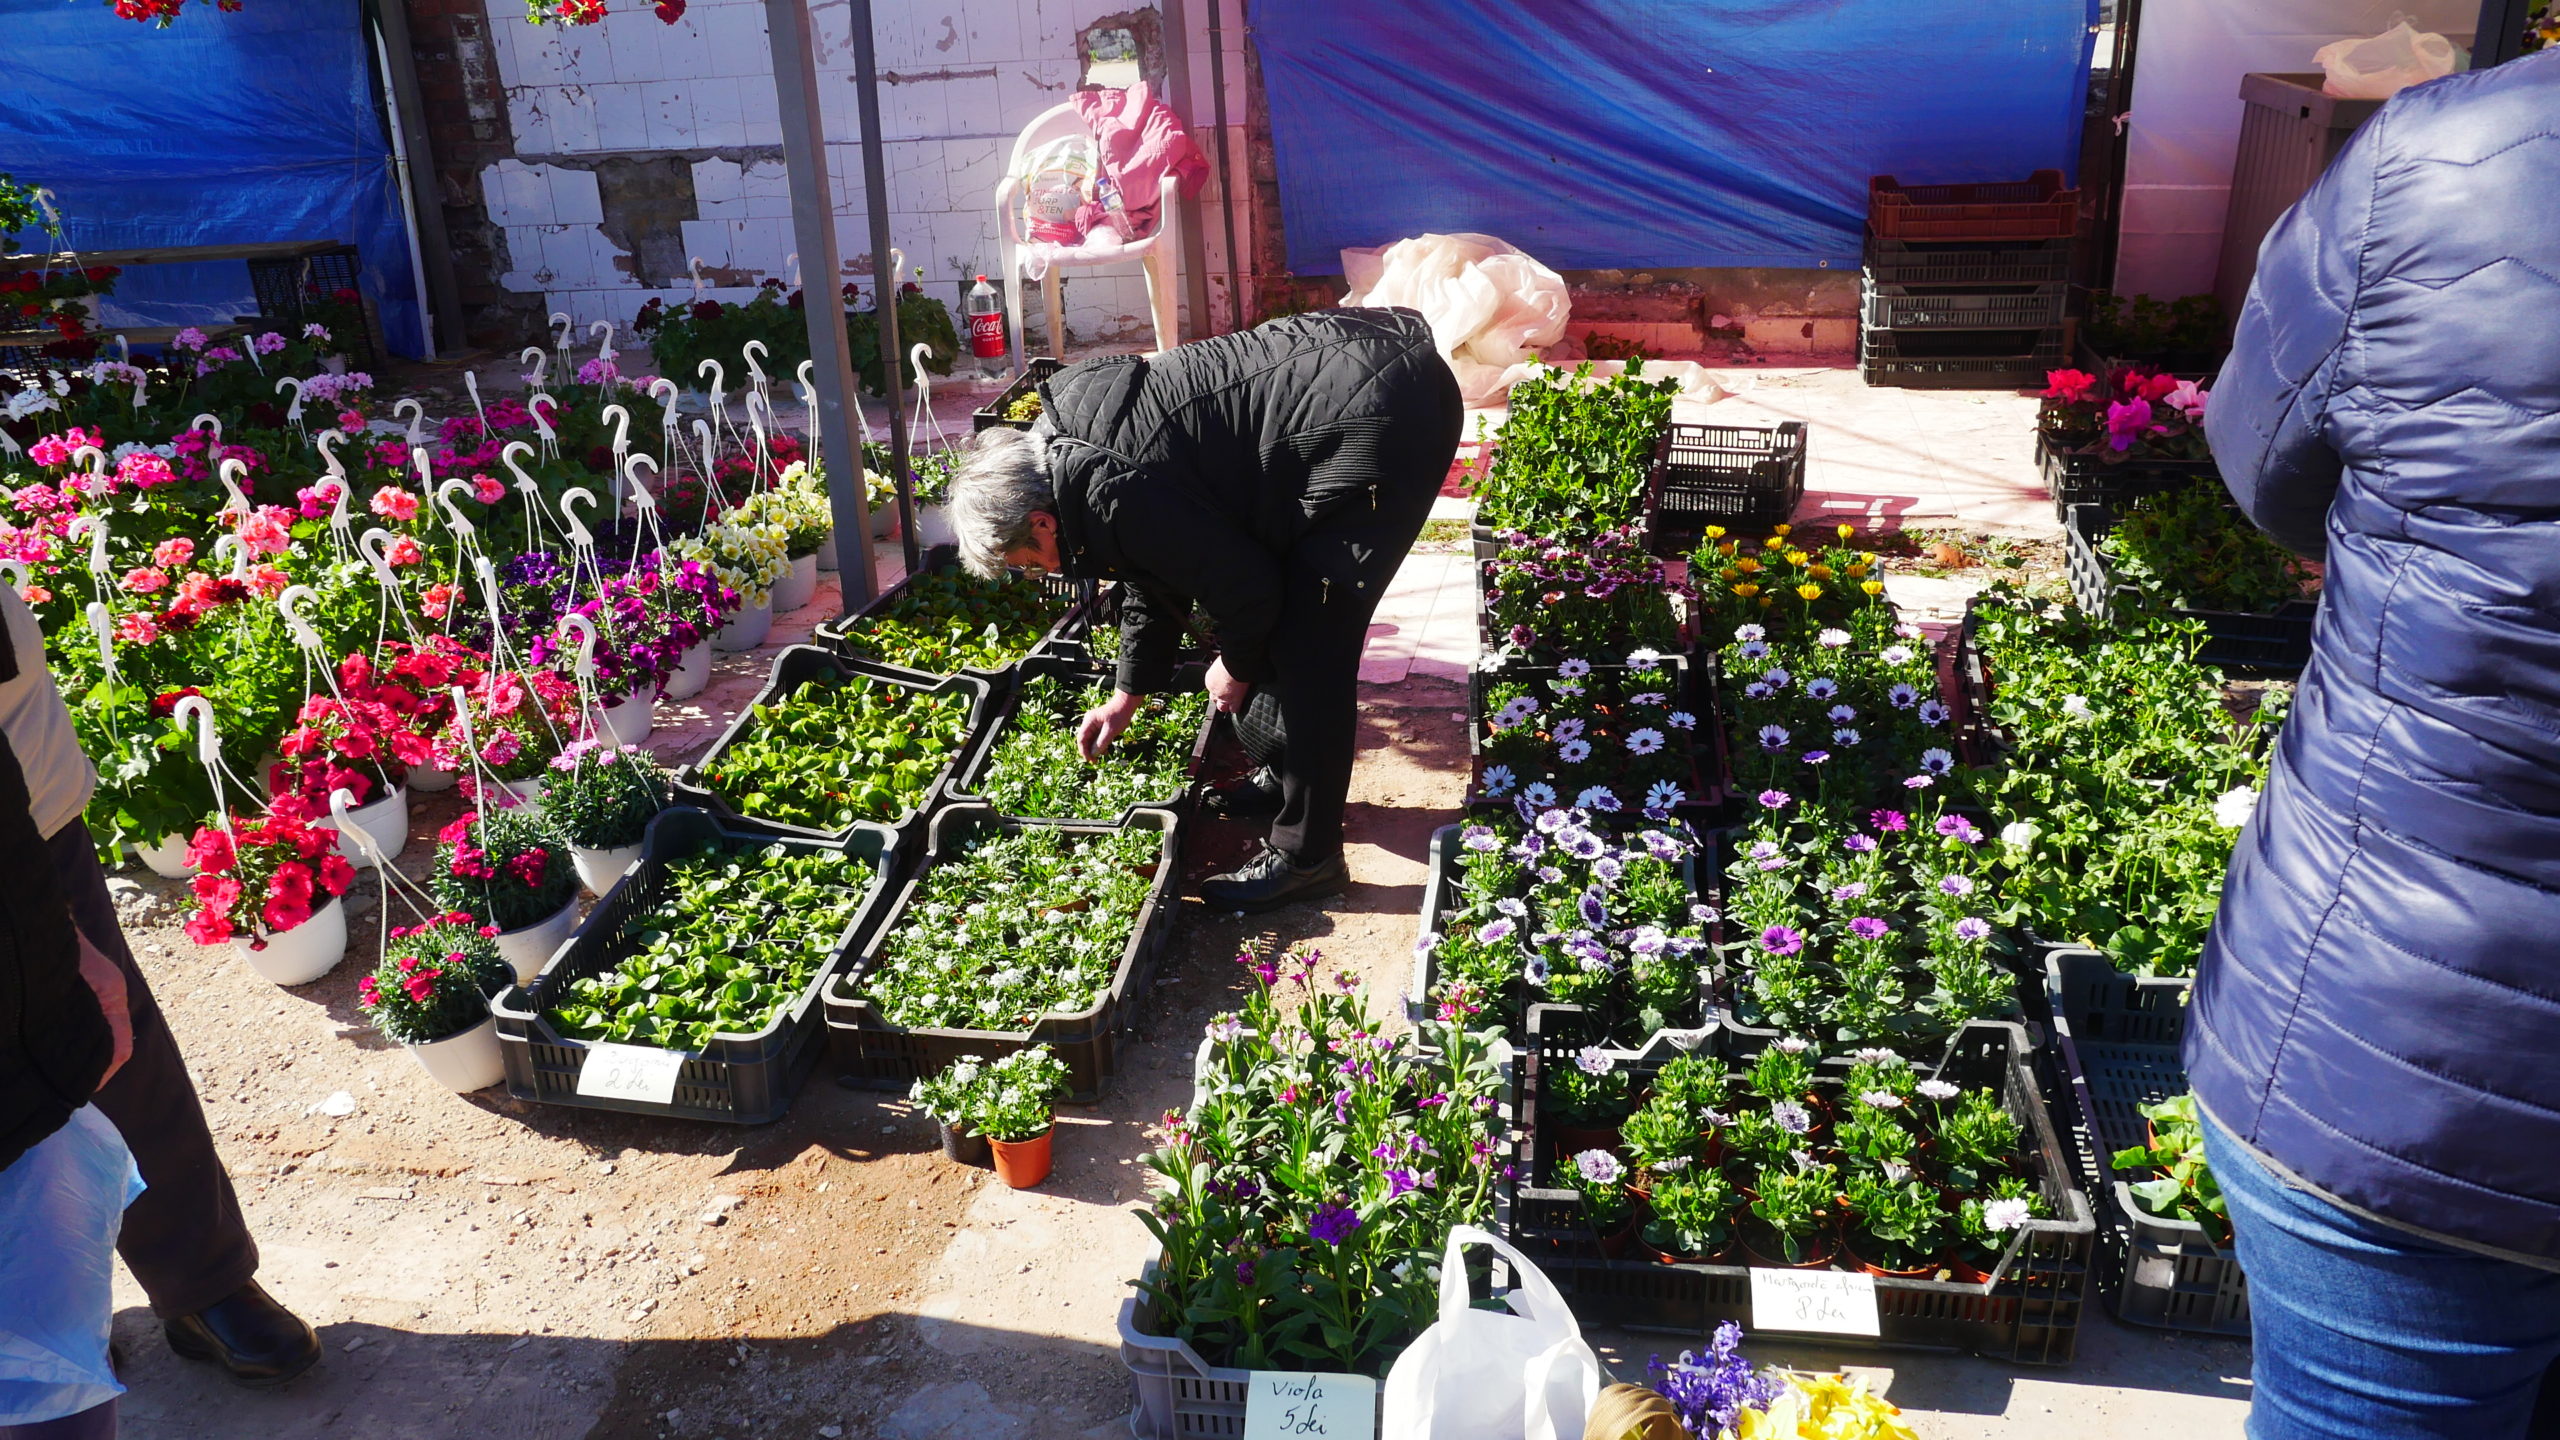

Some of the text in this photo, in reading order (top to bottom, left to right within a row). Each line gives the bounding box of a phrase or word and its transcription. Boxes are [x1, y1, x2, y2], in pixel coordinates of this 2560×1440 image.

[605, 1067, 622, 1089] 2
[1272, 1374, 1324, 1401] Viola
[1279, 1404, 1301, 1431] 5
